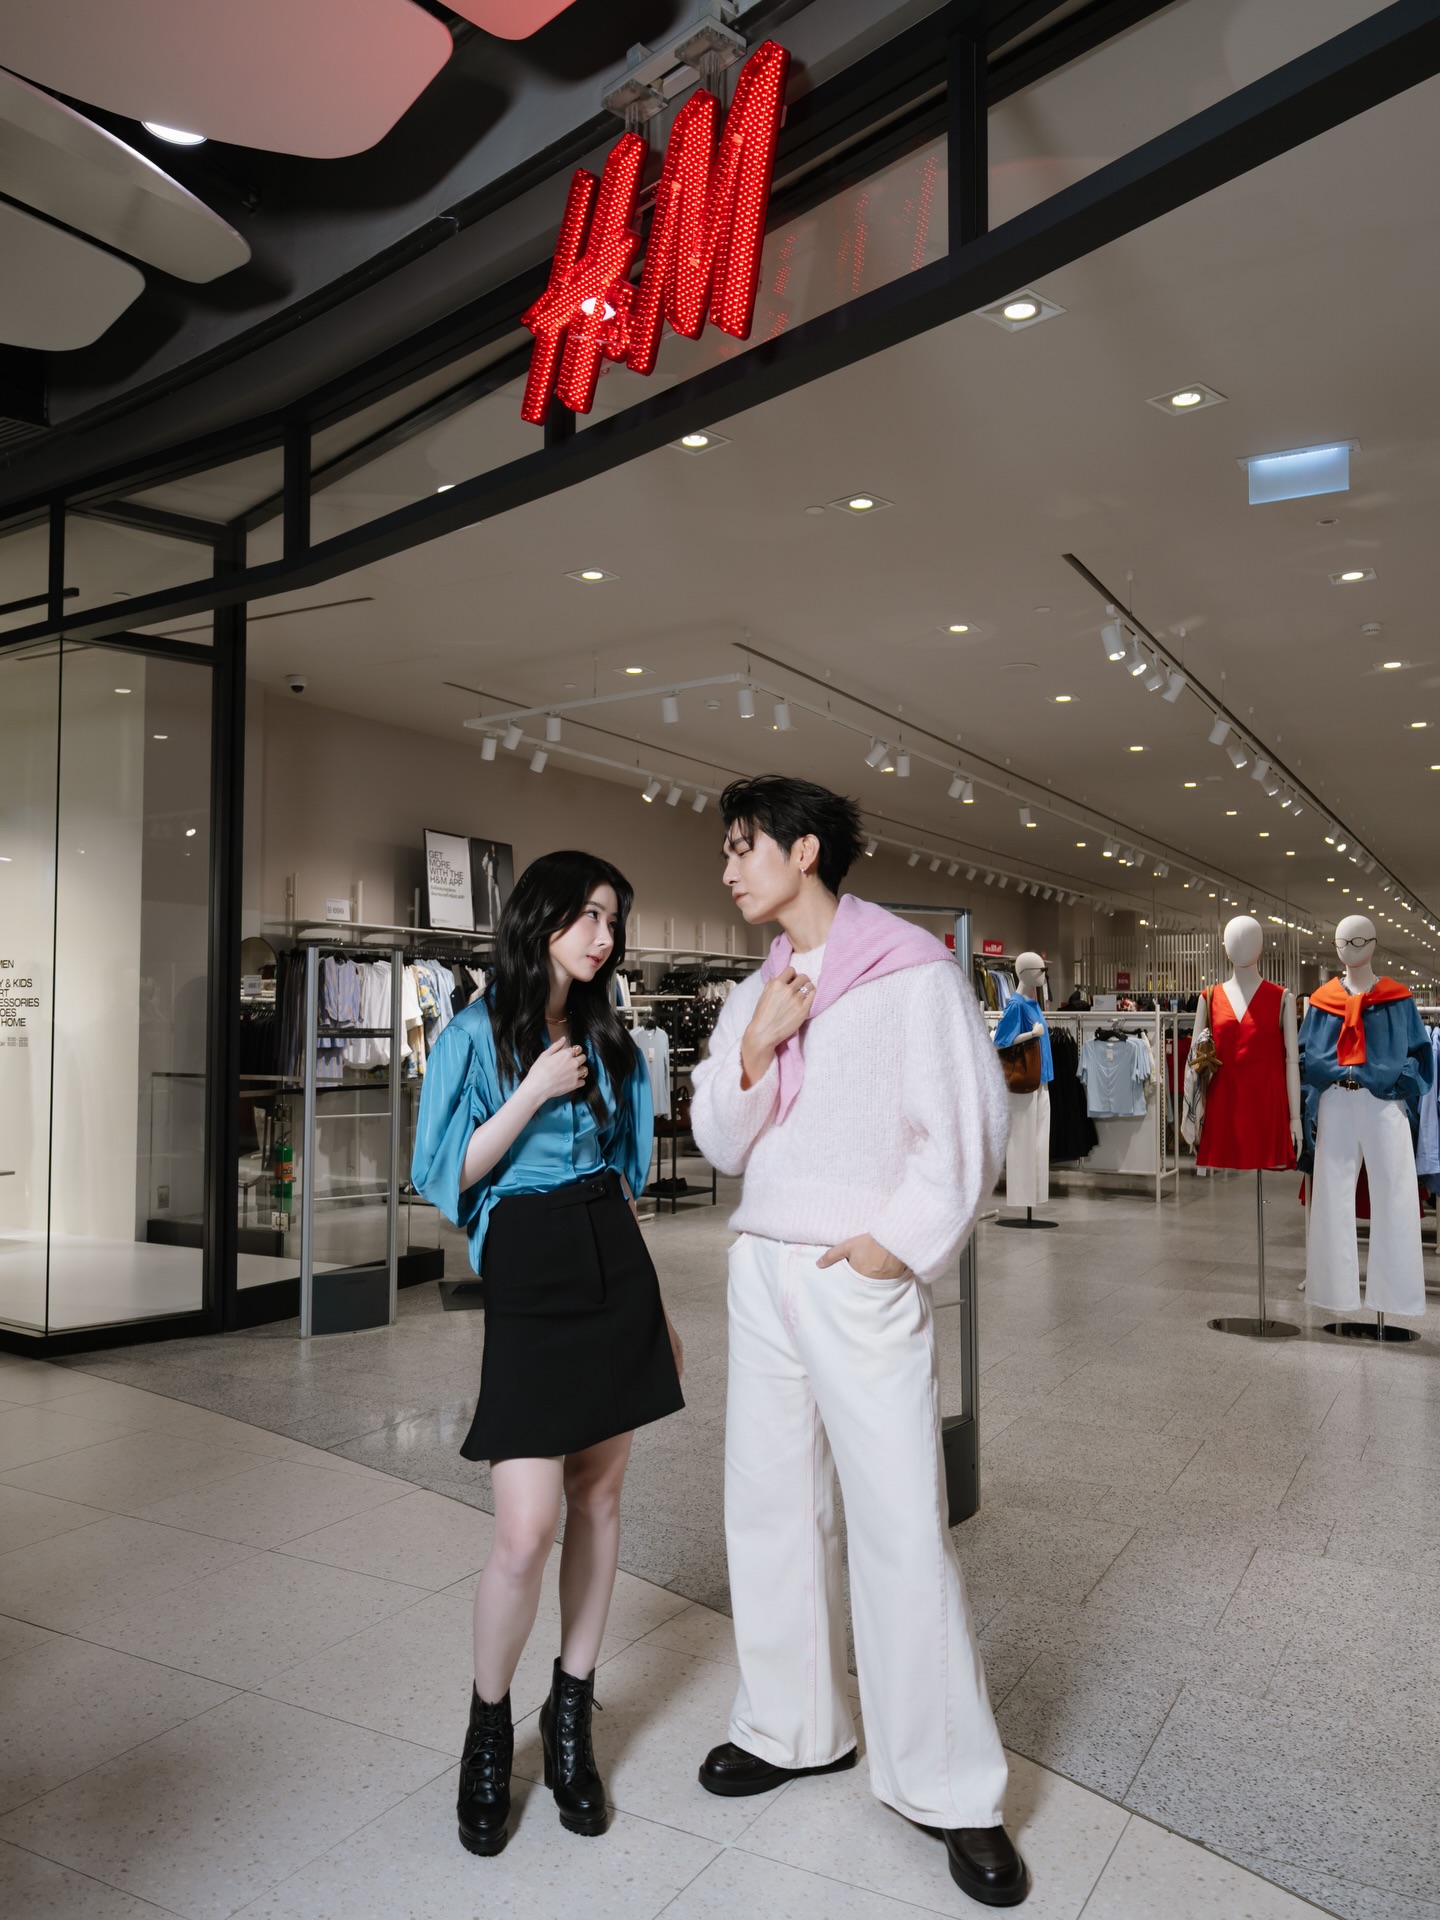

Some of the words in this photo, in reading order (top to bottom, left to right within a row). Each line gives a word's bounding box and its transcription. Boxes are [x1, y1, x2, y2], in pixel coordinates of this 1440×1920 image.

[522, 41, 791, 425] H&M
[428, 850, 443, 859] GET
[429, 859, 451, 869] MORE
[430, 867, 448, 877] WITH
[450, 870, 464, 879] THE
[430, 875, 447, 884] H&M
[449, 878, 463, 886] APP
[5, 979, 11, 988] &
[13, 979, 32, 987] KIDS
[1, 1018, 26, 1026] HOME
